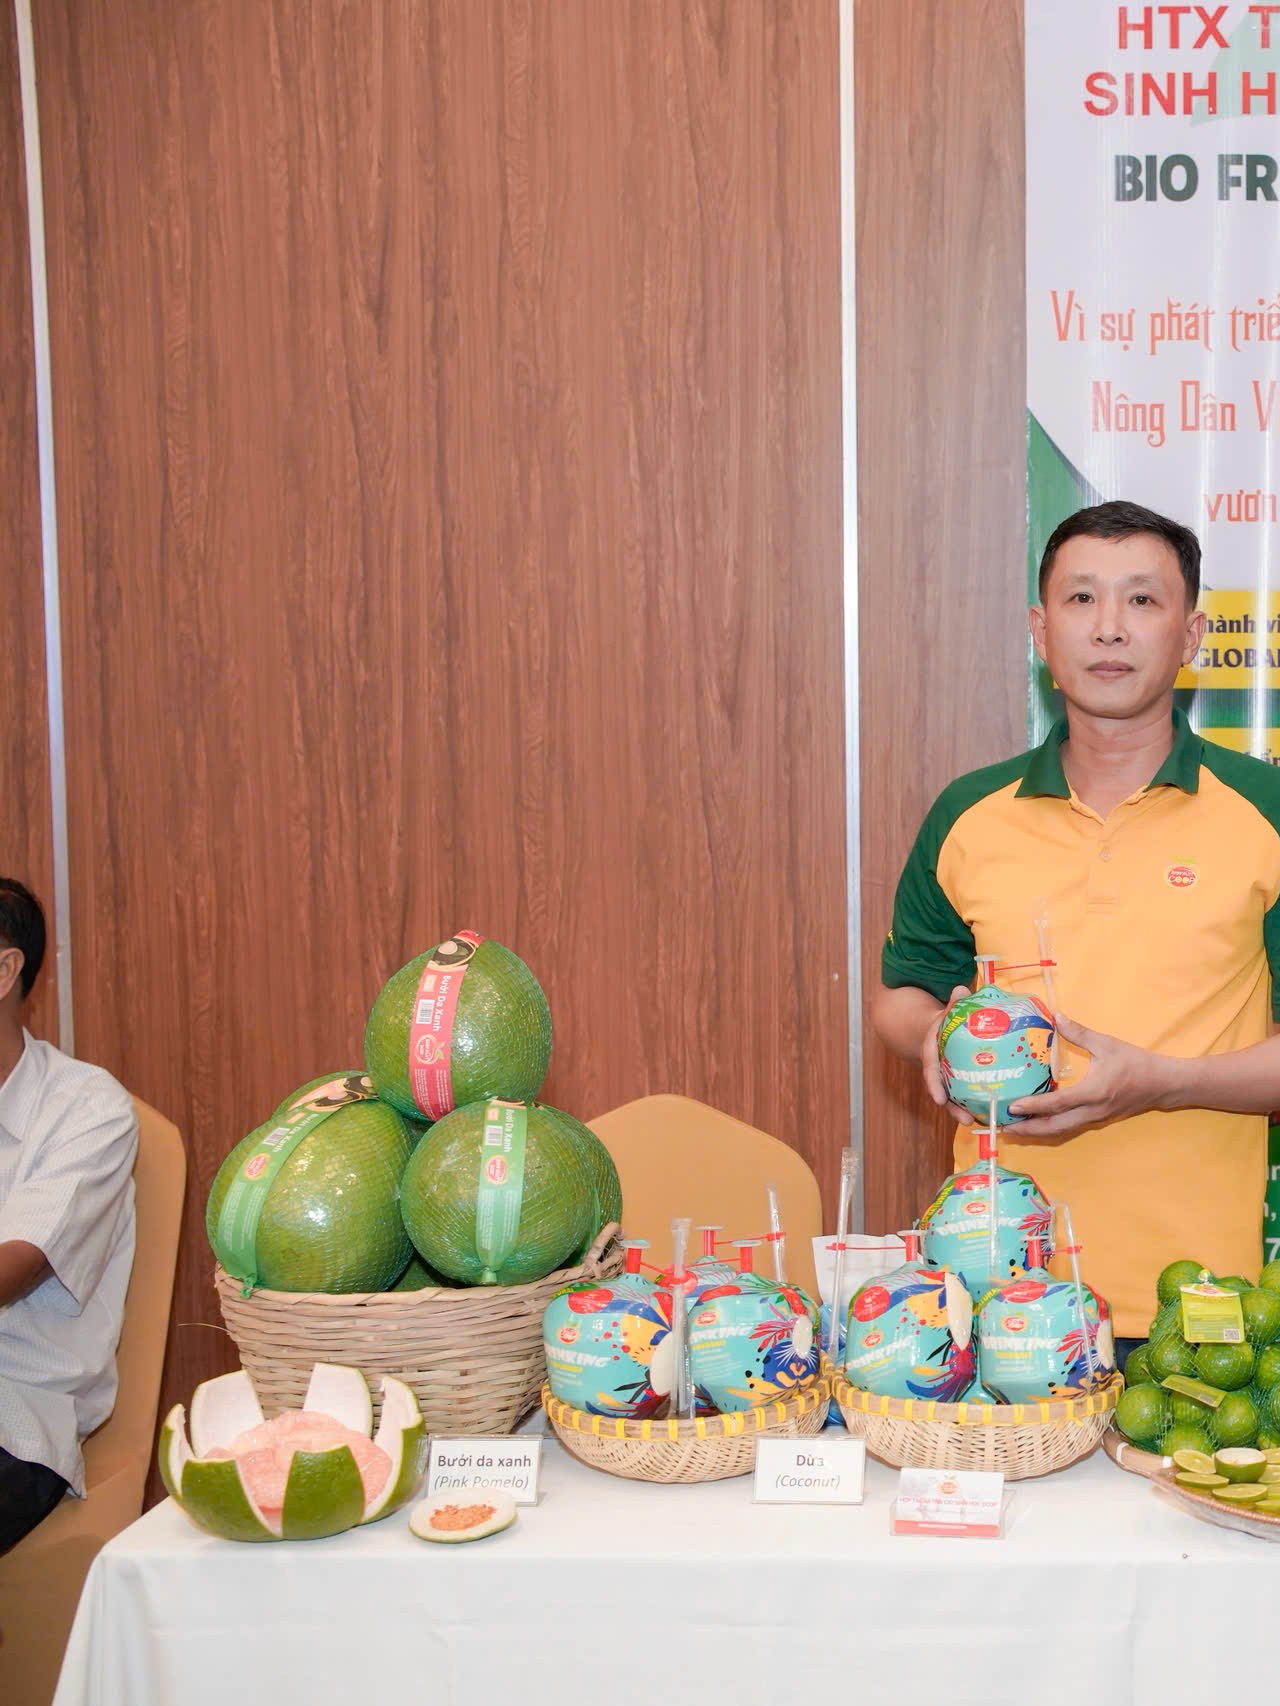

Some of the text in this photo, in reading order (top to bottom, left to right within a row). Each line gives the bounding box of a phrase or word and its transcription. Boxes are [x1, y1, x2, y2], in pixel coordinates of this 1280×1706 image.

[1118, 5, 1230, 49] HTX
[1084, 71, 1217, 116] SINH
[1114, 154, 1199, 202] BIO
[1050, 290, 1085, 341] Vì
[1100, 308, 1136, 351] sự
[1149, 297, 1216, 355] phát
[1092, 380, 1165, 448] Nông
[1181, 380, 1237, 432] Dân
[1203, 488, 1277, 523] vươn
[433, 1009, 444, 1031] Xanh
[476, 1455, 493, 1467] da
[498, 1455, 531, 1467] xanh
[434, 1475, 529, 1490] (Pink Pomelo)
[775, 1474, 841, 1489] (Coconut)
